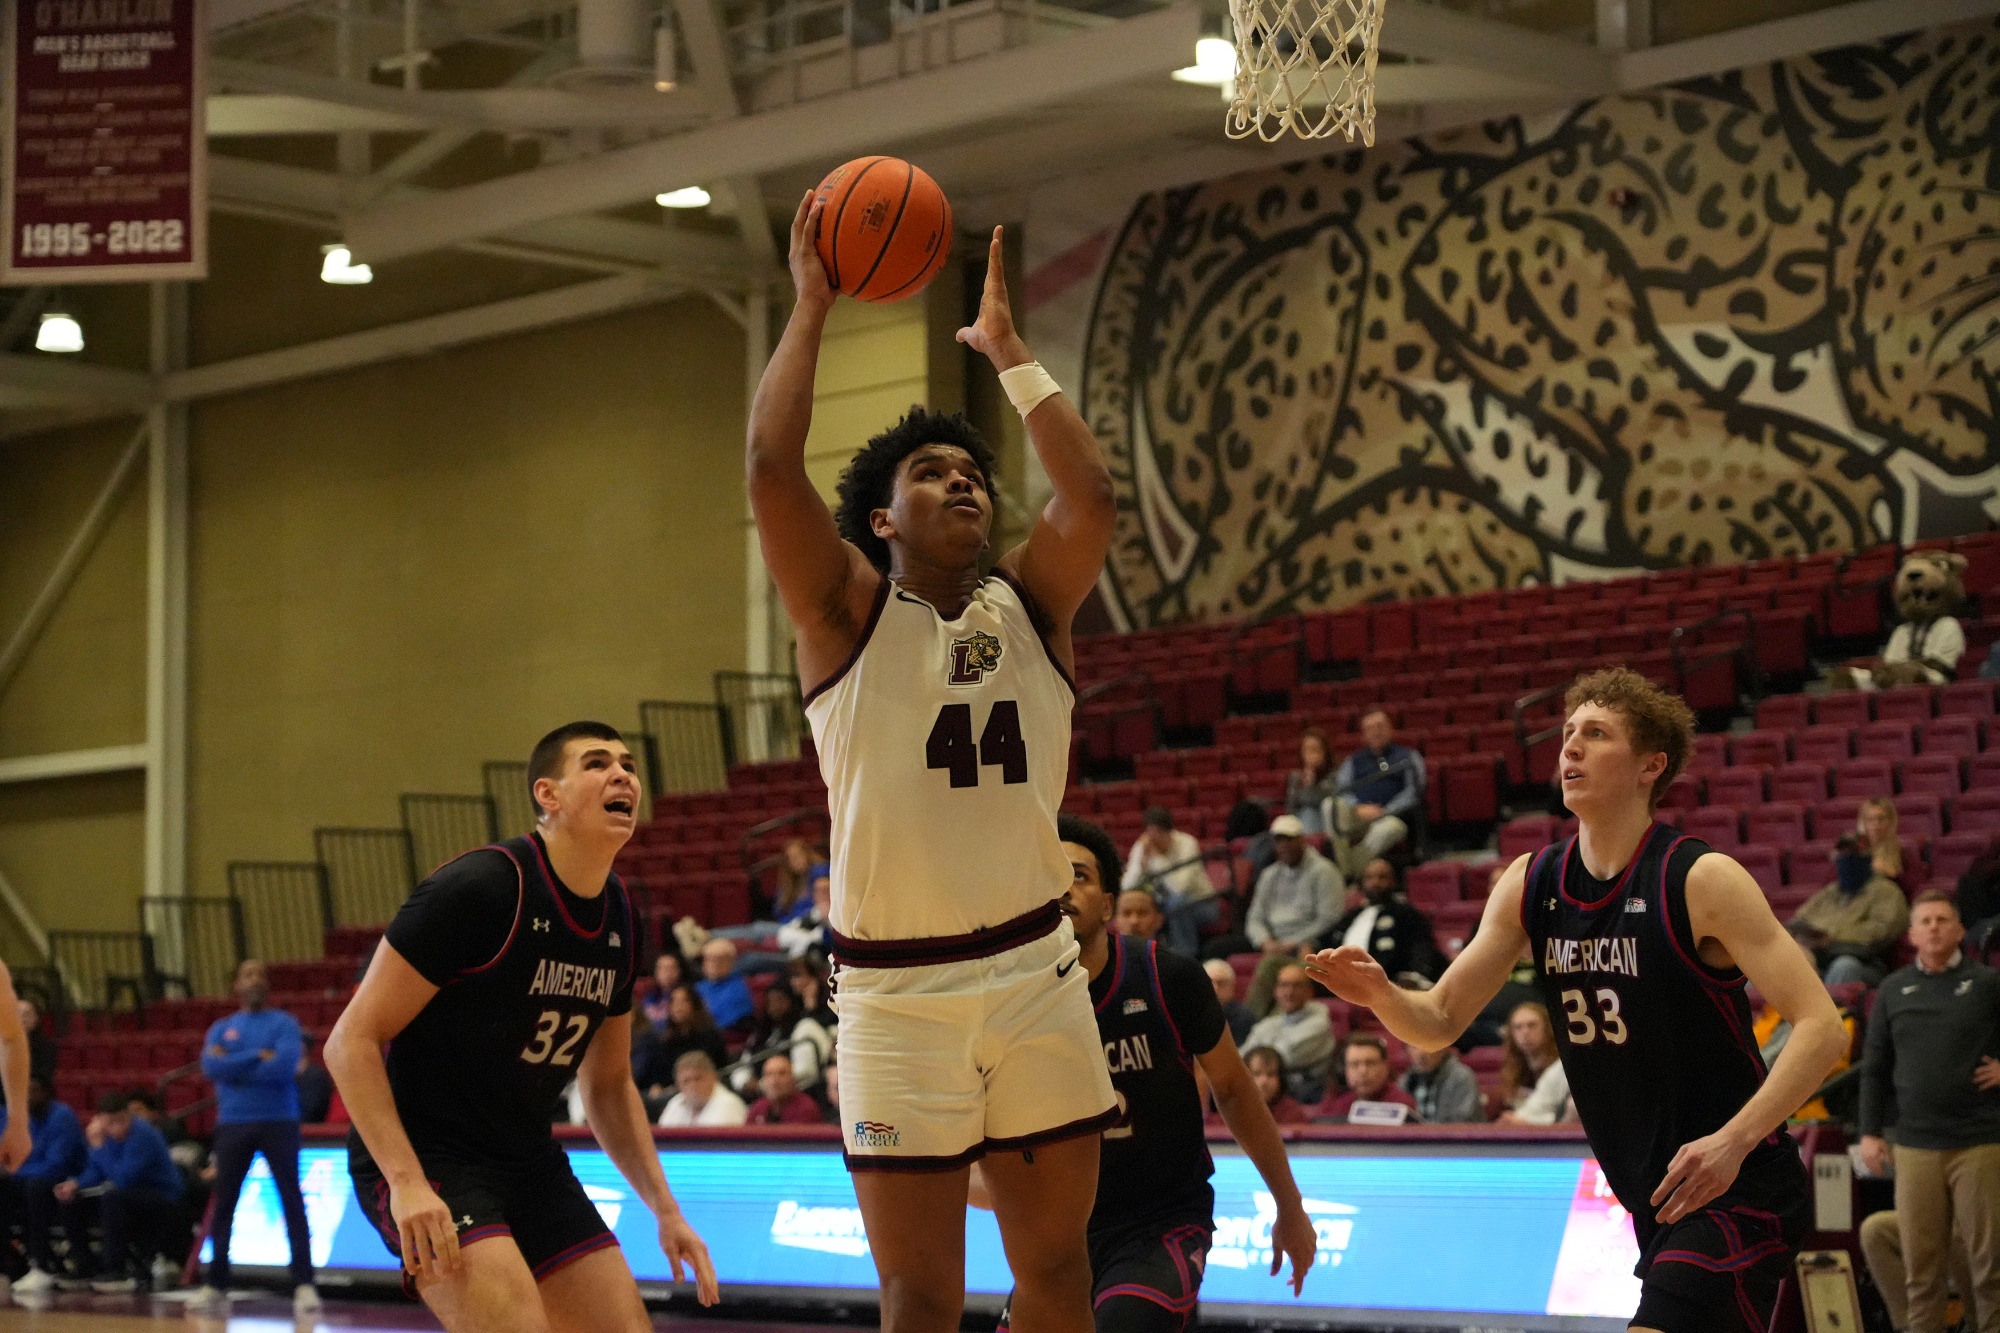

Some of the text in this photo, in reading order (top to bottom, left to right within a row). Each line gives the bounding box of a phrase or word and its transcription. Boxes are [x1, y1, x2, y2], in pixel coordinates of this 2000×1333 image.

[82, 32, 176, 50] BASKETBALL
[925, 700, 1028, 788] 44
[528, 958, 617, 1007] AMERICAN
[1545, 937, 1638, 977] AMERICAN
[520, 1010, 590, 1066] 32
[1561, 987, 1628, 1045] 33
